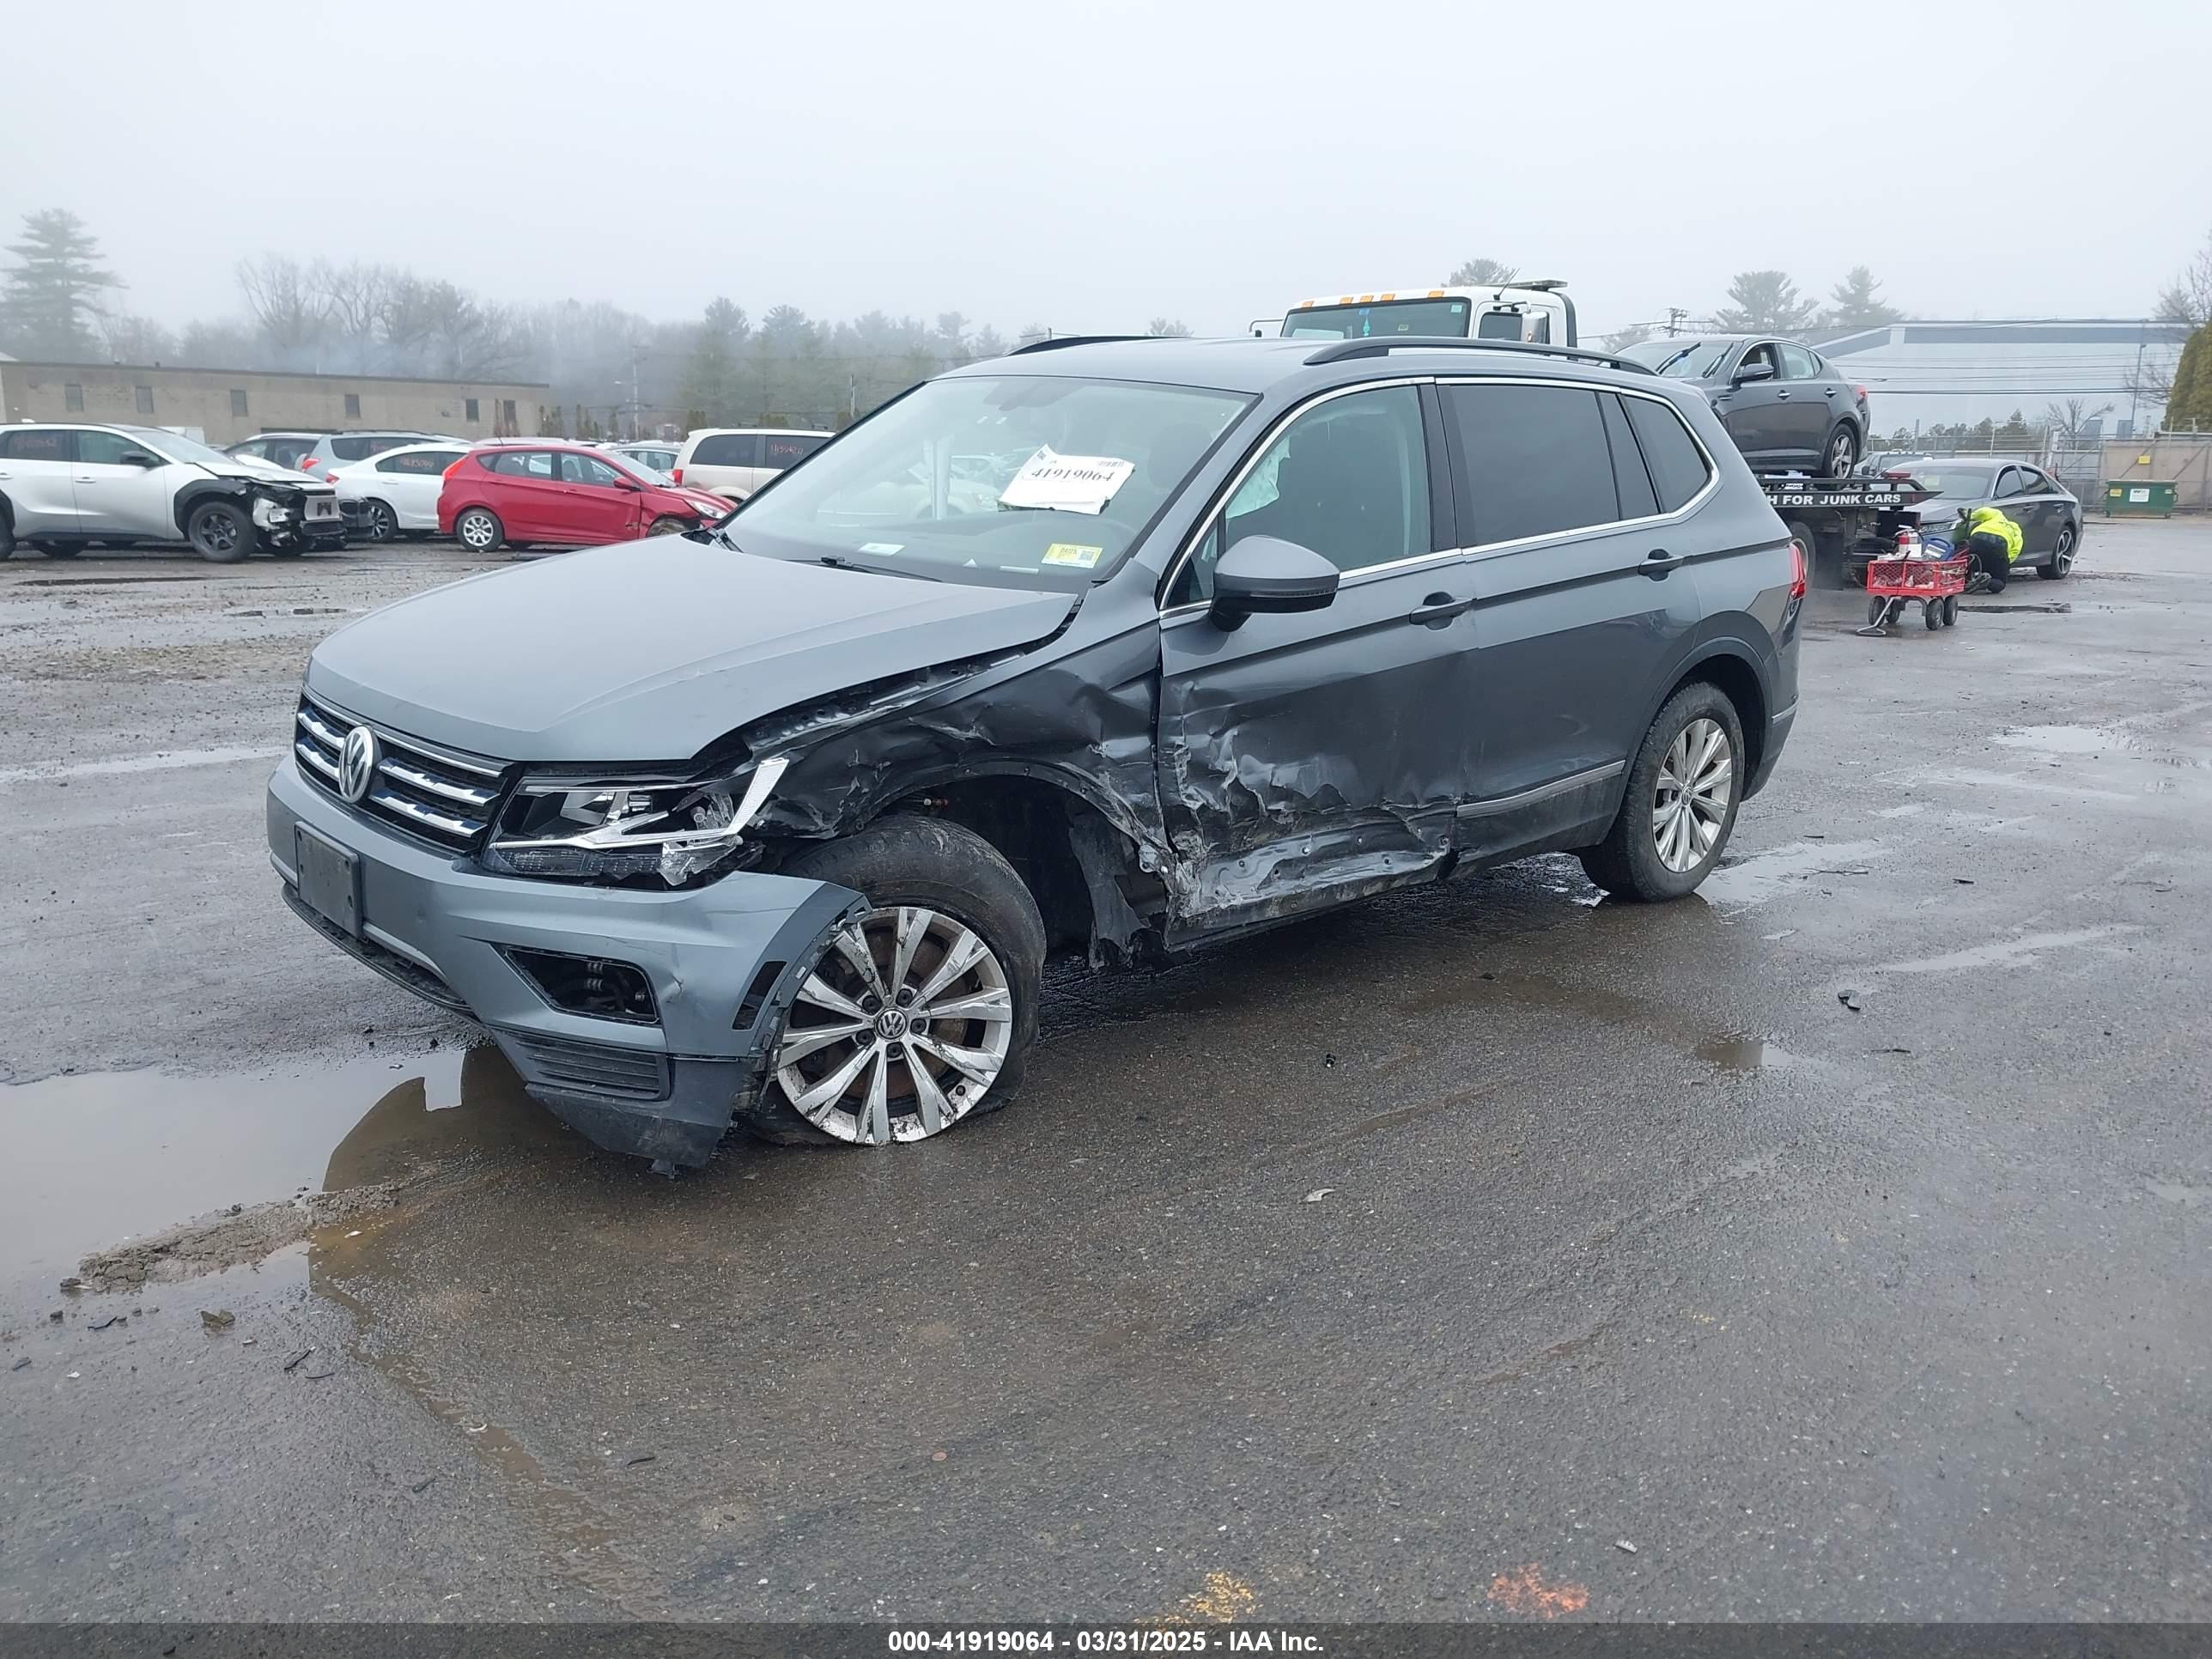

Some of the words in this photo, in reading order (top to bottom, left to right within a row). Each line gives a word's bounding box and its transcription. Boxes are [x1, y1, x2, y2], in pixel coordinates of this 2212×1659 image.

[1032, 468, 1115, 481] 41919064
[1782, 495, 1814, 505] FOR
[1820, 495, 1861, 505] JUNK
[1864, 494, 1902, 504] CARS
